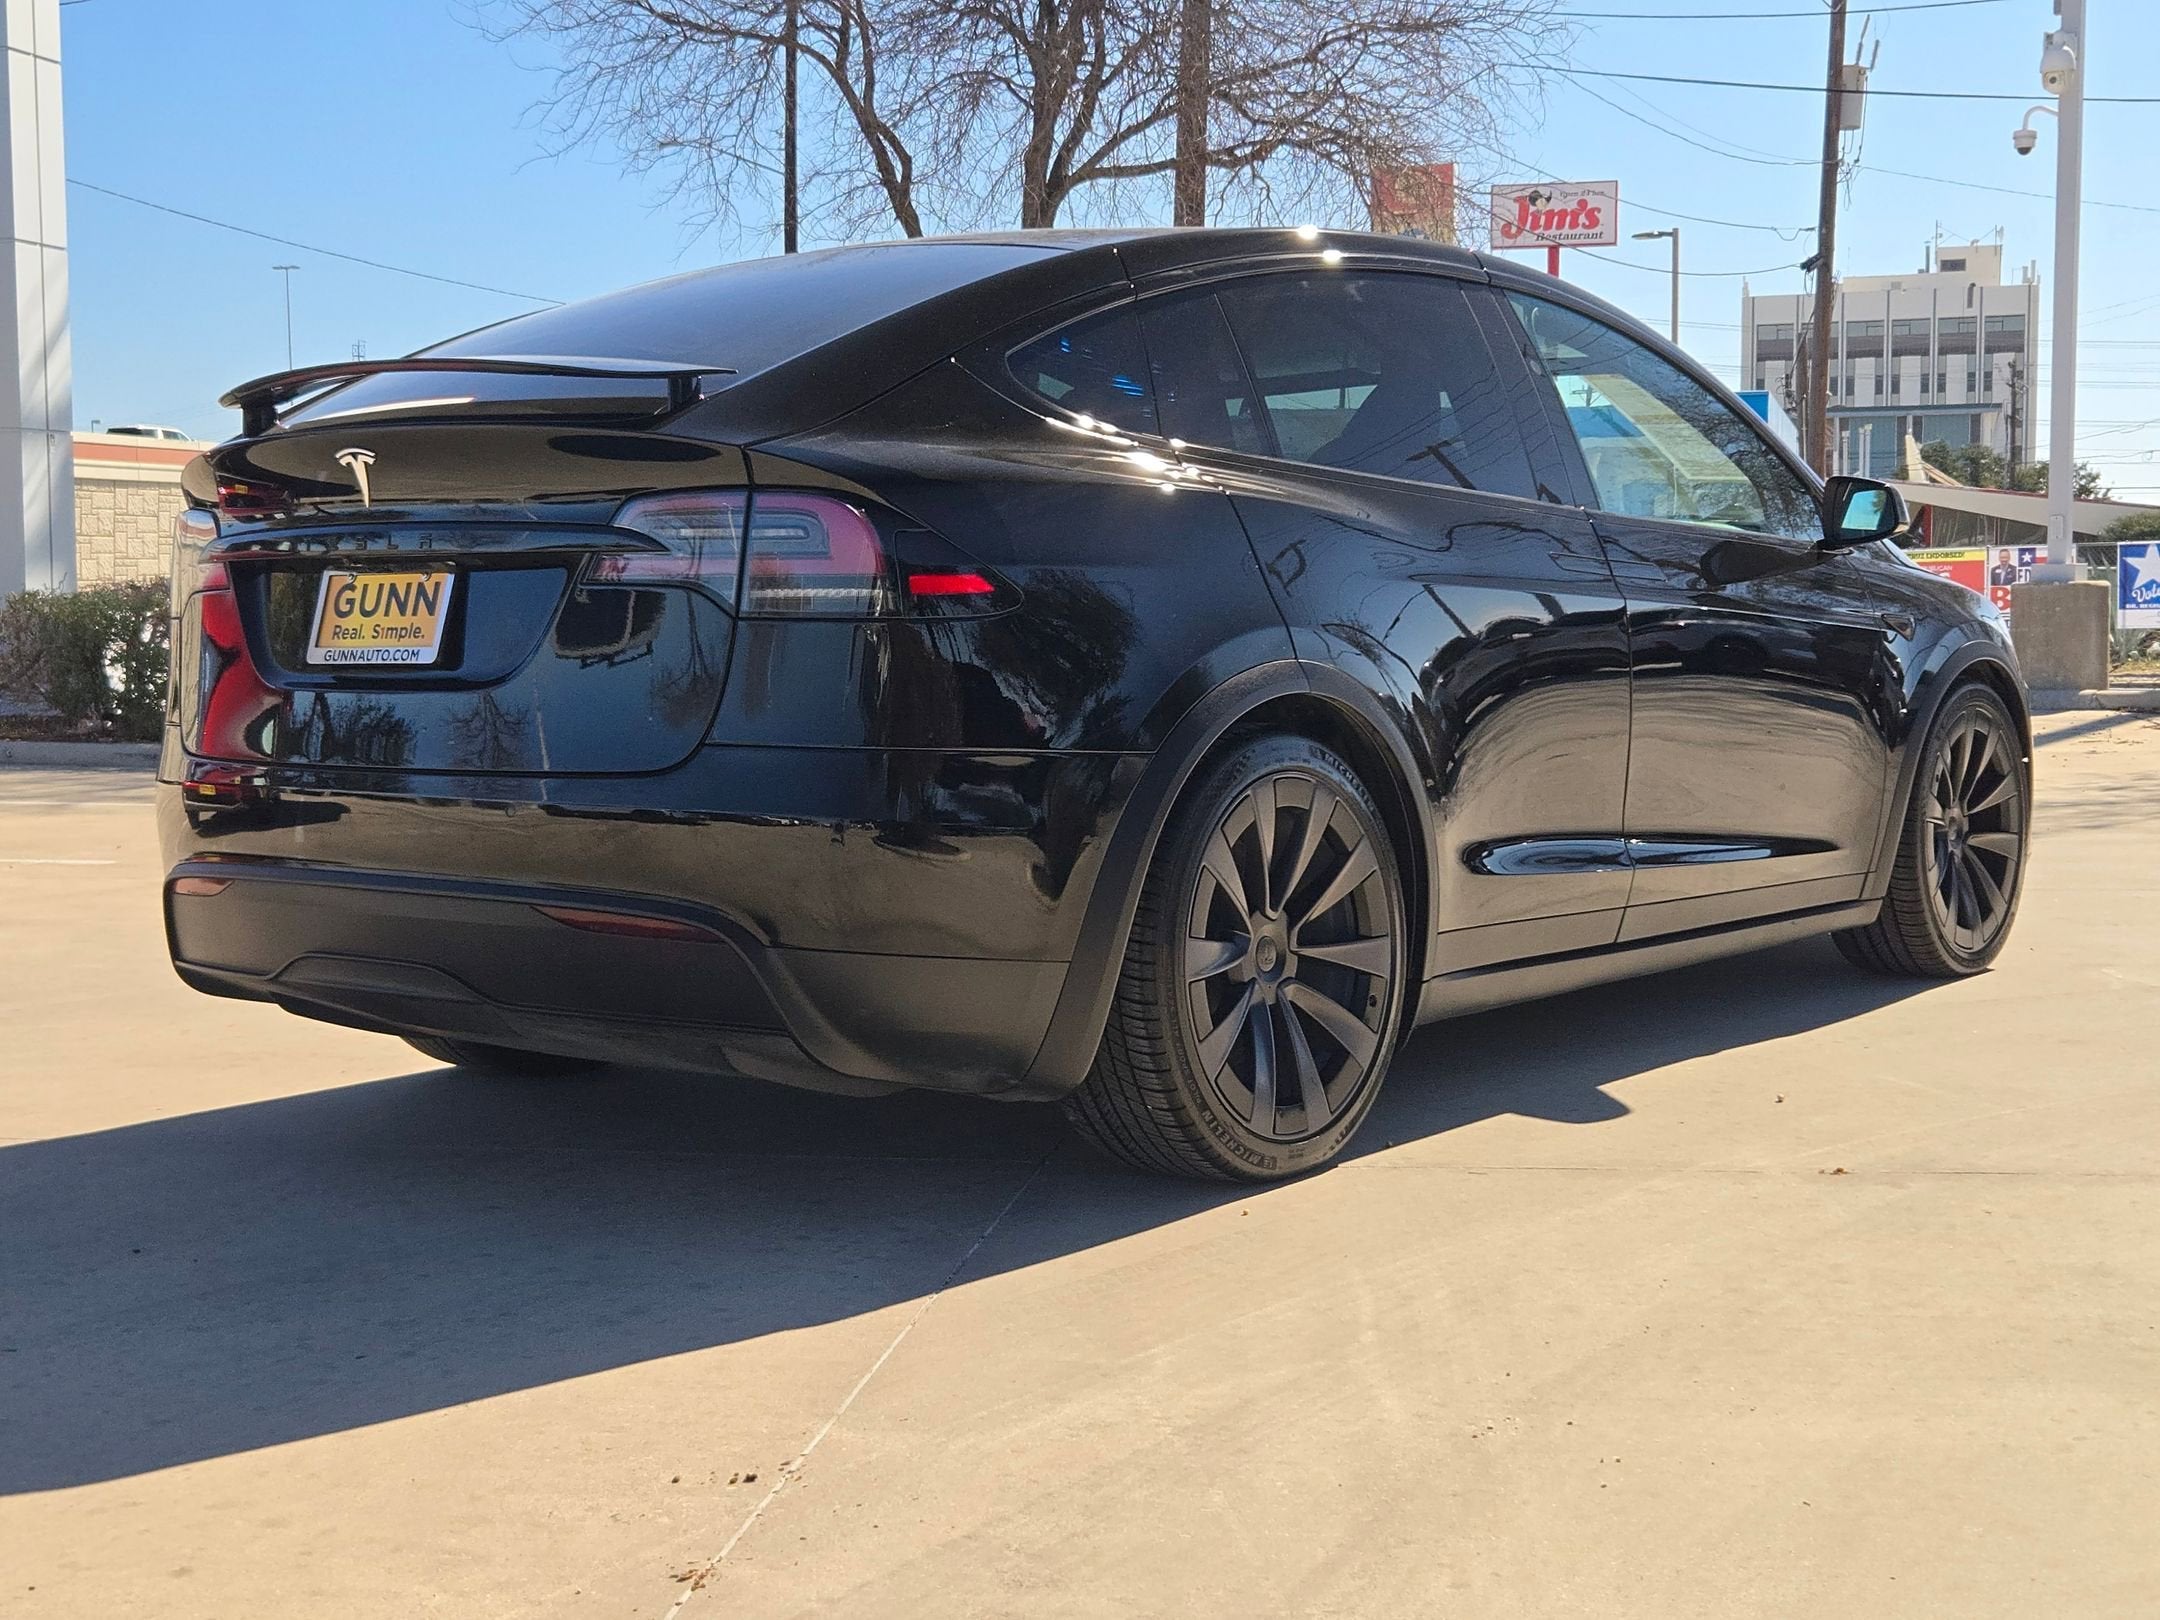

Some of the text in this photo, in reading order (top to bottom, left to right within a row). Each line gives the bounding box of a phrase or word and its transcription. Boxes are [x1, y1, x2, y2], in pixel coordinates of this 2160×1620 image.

[1501, 196, 1601, 239] Jim's
[1535, 231, 1604, 241] Restaurant
[333, 581, 441, 618] GUNN
[332, 624, 365, 640] Real.
[324, 649, 420, 662] GUNNAUTO.COM
[1201, 1110, 1262, 1167] MICHELIN
